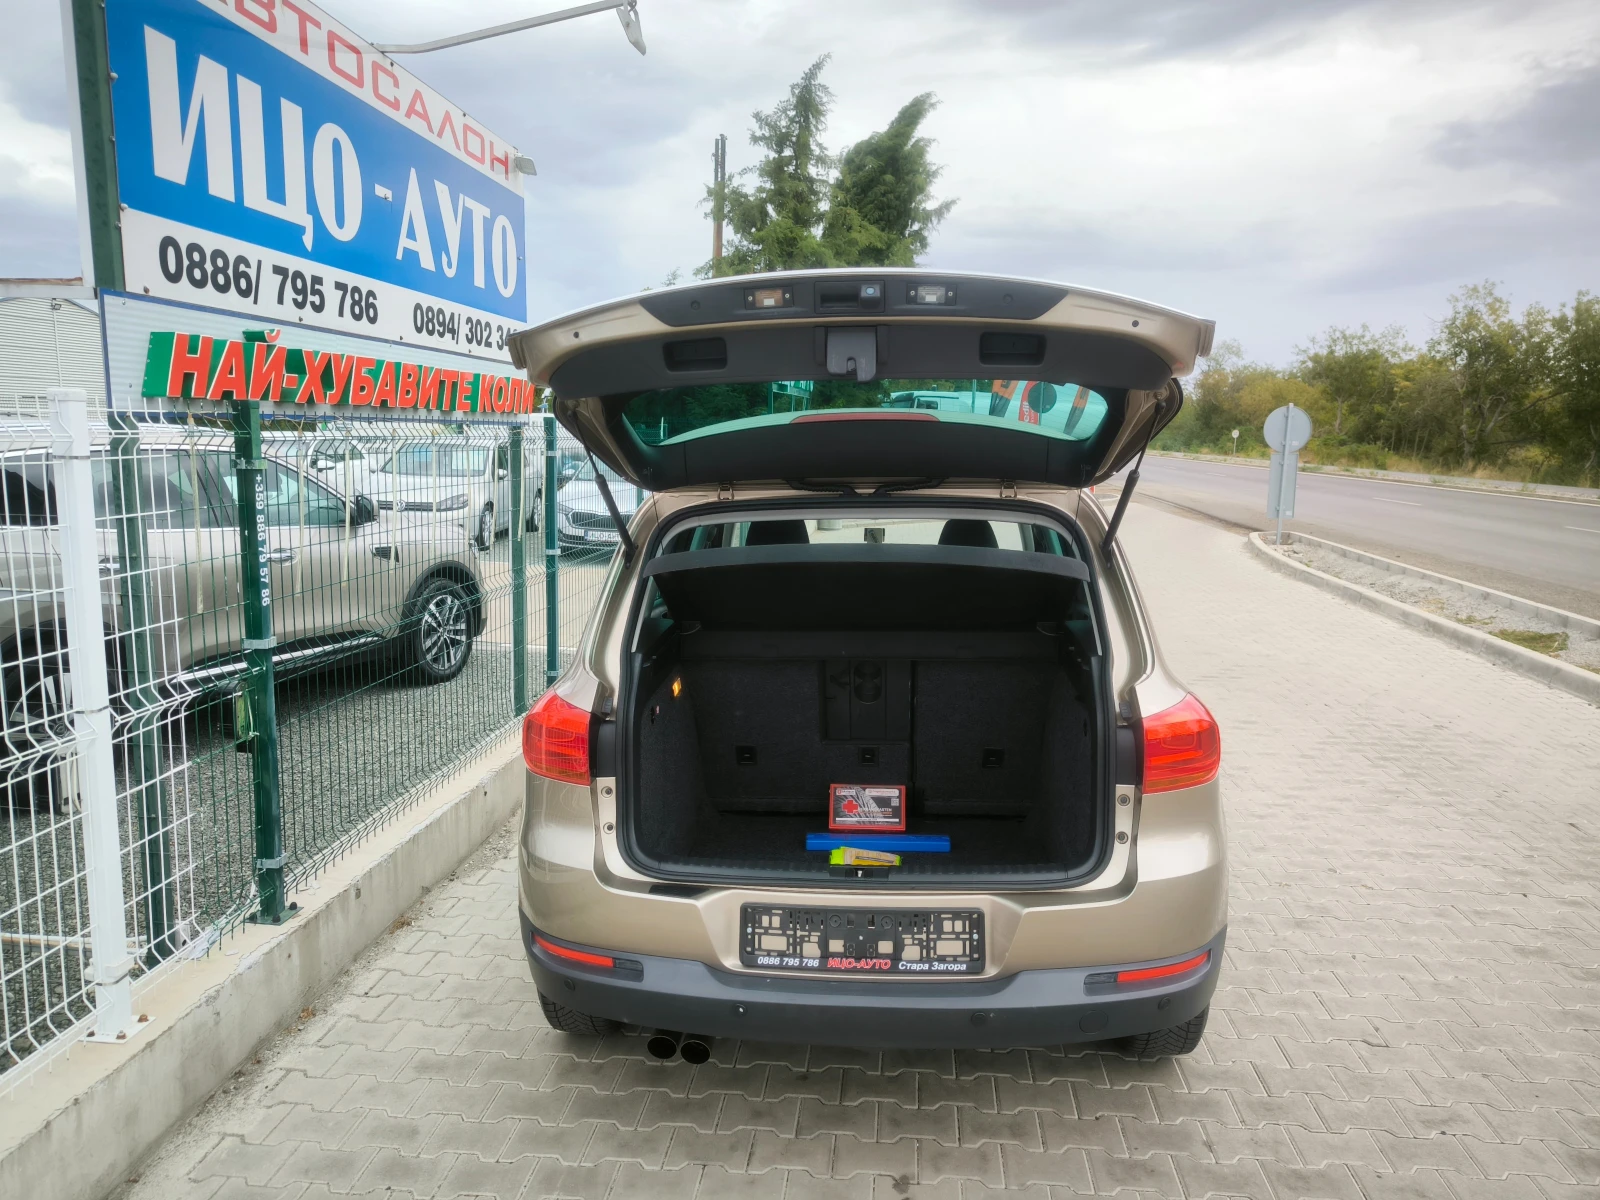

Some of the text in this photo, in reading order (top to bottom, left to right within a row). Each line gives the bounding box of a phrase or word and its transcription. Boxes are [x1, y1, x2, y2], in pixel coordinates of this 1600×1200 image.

[218, 0, 510, 182] ТОСАЛОН
[158, 235, 518, 351] 0886/ 795 786 0894/ 302 34
[167, 329, 534, 414] НАЙ-ХУБАВИТЕ КОЛИ
[255, 473, 271, 607] +359 886 79 57 86
[757, 956, 967, 972] 0886 795 786 ИЦО-АУТО Стара Загора
